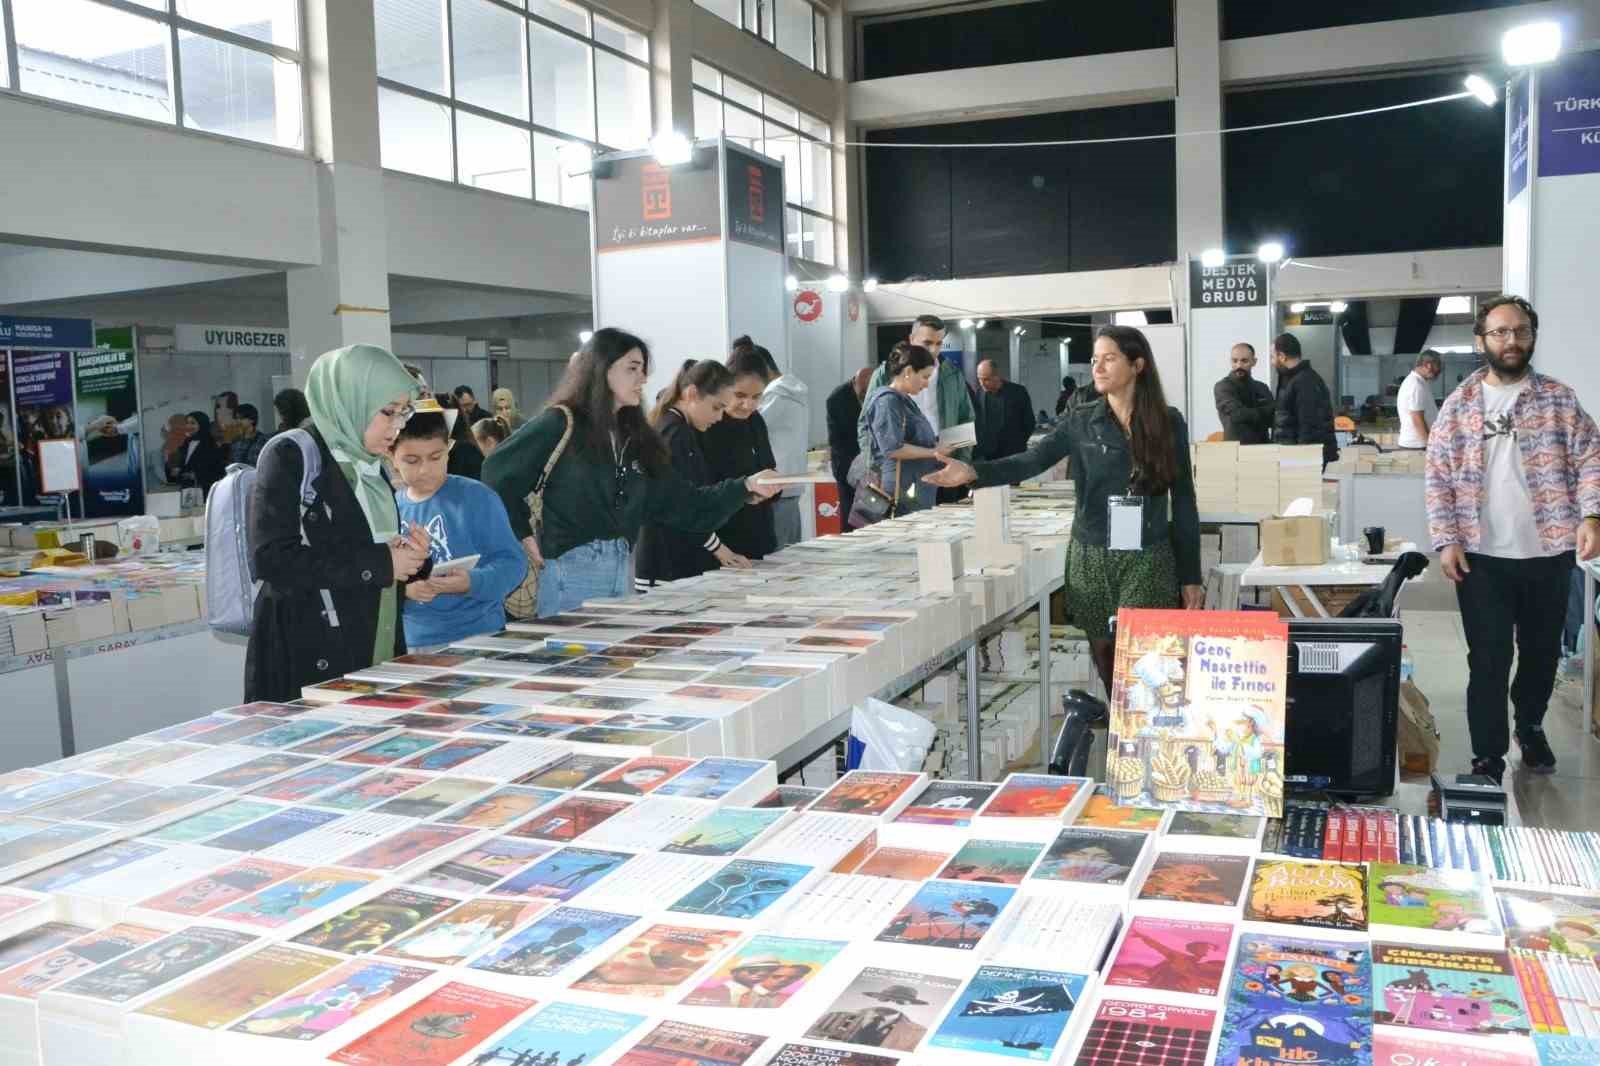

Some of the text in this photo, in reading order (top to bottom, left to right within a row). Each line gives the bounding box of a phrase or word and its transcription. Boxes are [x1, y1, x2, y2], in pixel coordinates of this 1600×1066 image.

[1202, 264, 1256, 276] DESTEK
[1202, 277, 1256, 290] MEDYA
[1202, 290, 1257, 303] GRUBU
[205, 330, 286, 347] UYURGEZER
[1194, 641, 1232, 658] Genç
[1211, 676, 1226, 690] ile
[1101, 1006, 1168, 1020] 1984
[1104, 1000, 1209, 1016] GEORGE ORWELL
